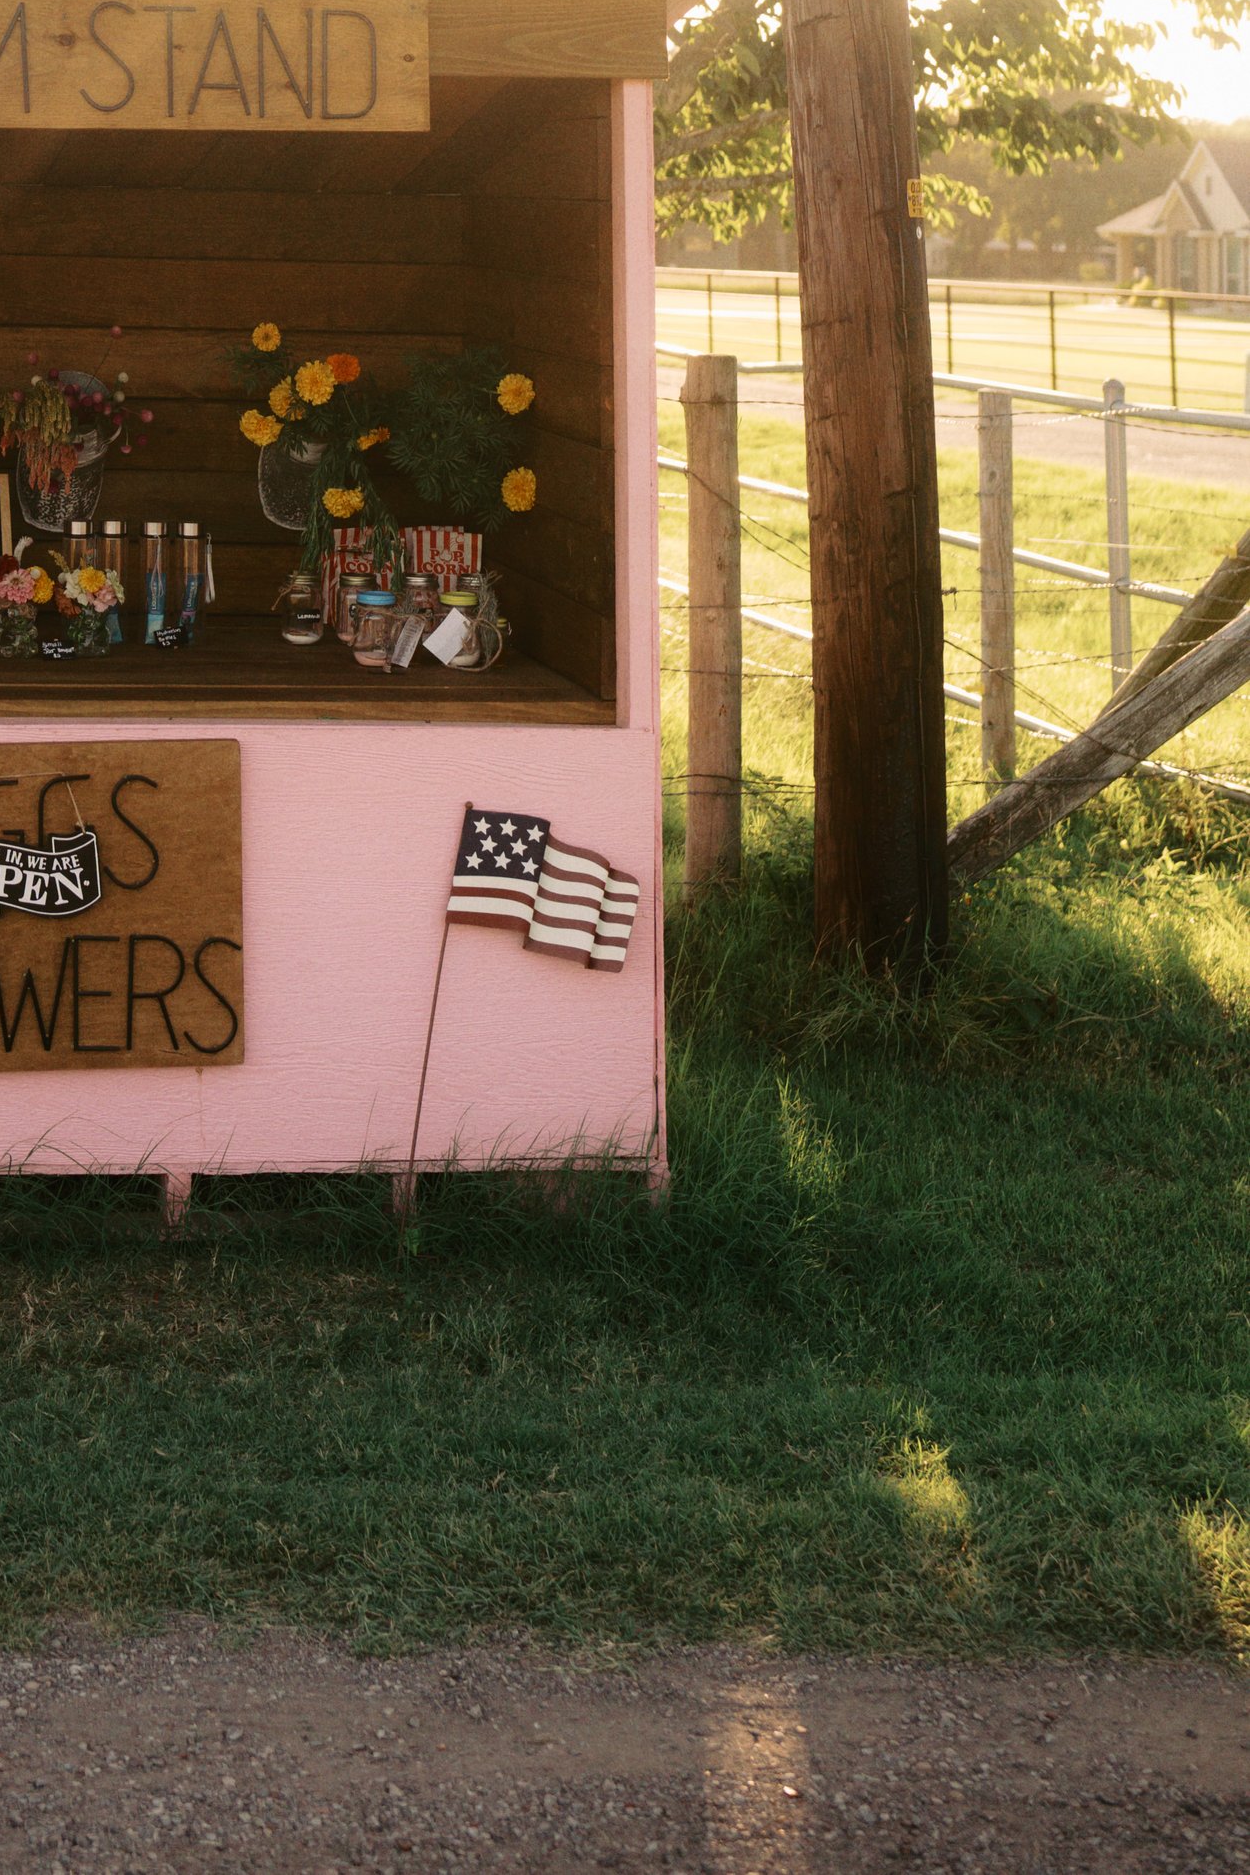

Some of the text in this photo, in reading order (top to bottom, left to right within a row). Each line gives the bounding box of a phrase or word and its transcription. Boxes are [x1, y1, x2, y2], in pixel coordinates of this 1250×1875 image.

[80, 0, 378, 120] STAND
[422, 561, 470, 576] CORN
[5, 848, 24, 868] IN,
[27, 855, 48, 869] WE
[52, 853, 80, 871] ARE
